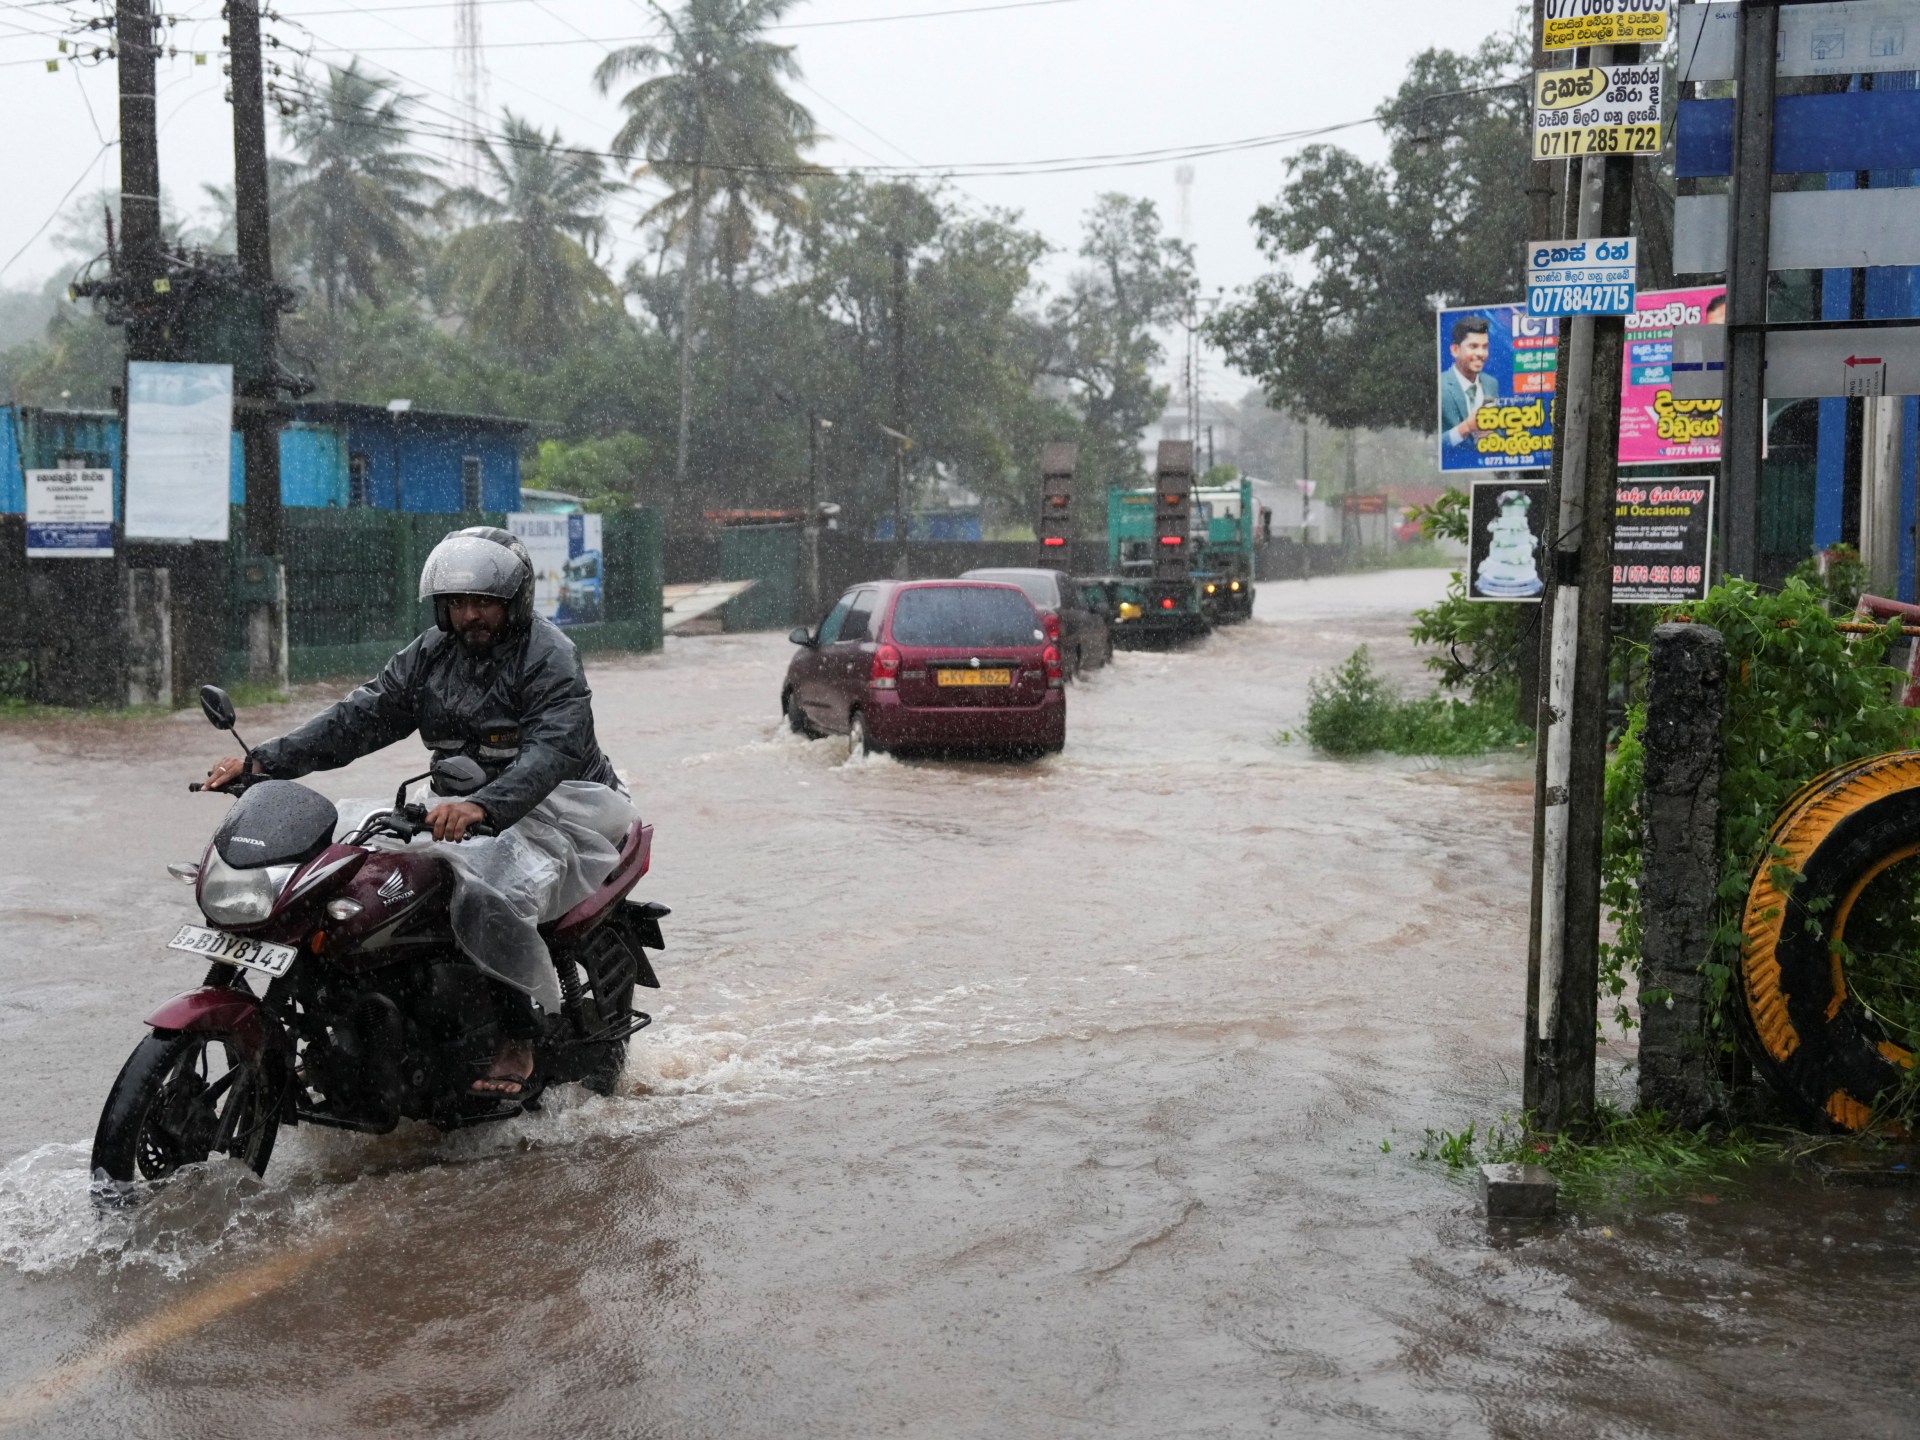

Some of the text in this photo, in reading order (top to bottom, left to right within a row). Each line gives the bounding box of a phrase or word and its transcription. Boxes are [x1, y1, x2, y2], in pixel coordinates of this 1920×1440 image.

[1612, 67, 1660, 86] රත්තරන්
[1540, 69, 1594, 106] උකස්
[1606, 86, 1643, 103] බේරා
[1538, 110, 1569, 127] වැඩිම
[1572, 108, 1600, 126] මිලට
[1603, 110, 1623, 126] ගනු
[1540, 126, 1656, 156] 0717 285 722
[1533, 241, 1629, 268] උකස් රන්
[1564, 270, 1585, 283] මිලට
[1588, 271, 1603, 283] ගනු
[1532, 285, 1630, 313] 0778842715
[1616, 486, 1704, 505] ake Galary
[1630, 505, 1691, 516] Occasions
[1628, 565, 1649, 583] 076
[1670, 565, 1685, 583] 68
[1686, 565, 1701, 583] 05
[230, 835, 266, 847] HONDA
[382, 889, 416, 907] HONDA
